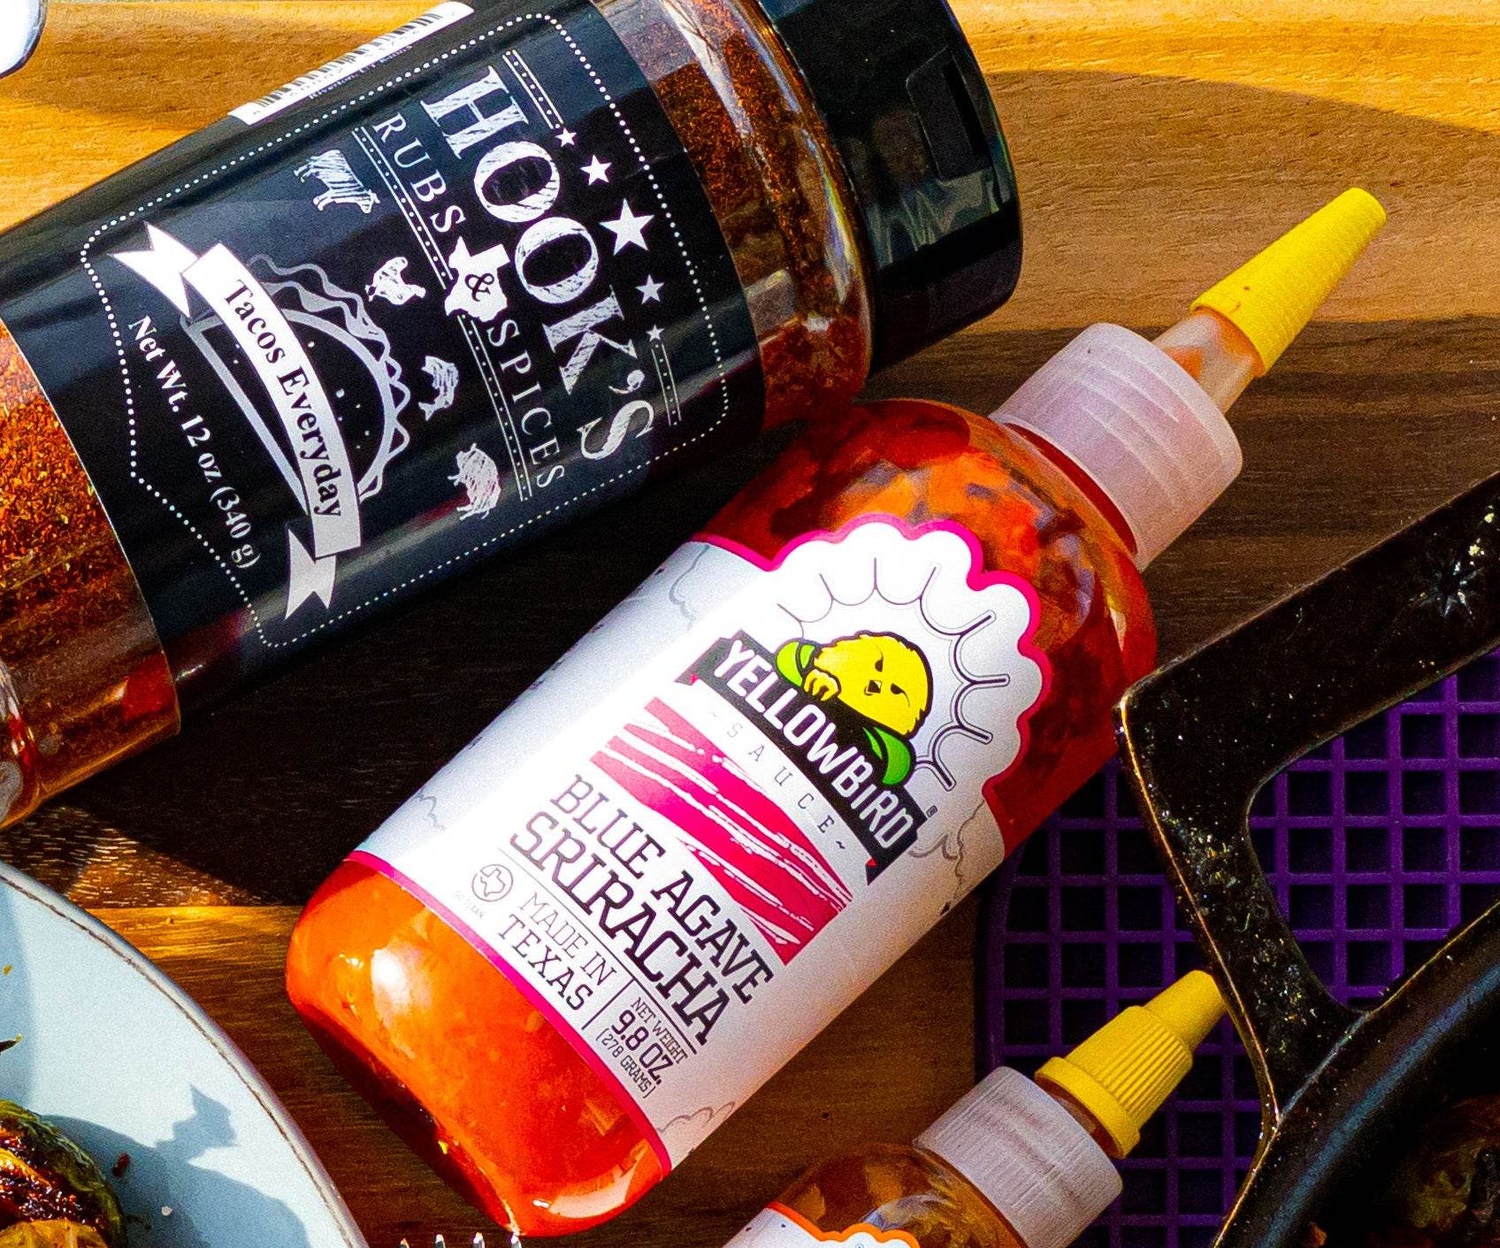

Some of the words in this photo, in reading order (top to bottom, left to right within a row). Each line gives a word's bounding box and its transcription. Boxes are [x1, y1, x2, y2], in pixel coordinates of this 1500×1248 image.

[372, 112, 466, 233] RUBS
[464, 272, 495, 302] &
[486, 318, 566, 488] SPICES
[420, 65, 655, 460] HOOK'S
[128, 315, 165, 361] Net
[156, 359, 188, 413] Wt.
[224, 279, 285, 364] Tacos
[276, 366, 342, 517] Everyday
[181, 415, 211, 447] 12
[198, 453, 222, 483] oz
[209, 486, 251, 539] (340
[231, 544, 261, 568] g)
[713, 639, 915, 850] YELLOWBIRD
[726, 722, 835, 834] SAUCE
[509, 811, 731, 1046] SRIRACHA
[549, 773, 666, 880] BLUE
[651, 869, 774, 1005] AGAVE
[498, 913, 594, 1011] TEXAS
[518, 891, 589, 959] MADE
[580, 951, 617, 986] IN
[595, 1027, 625, 1058] (278
[620, 1054, 657, 1099] GRAMS)
[611, 1008, 650, 1051] 9.8
[638, 1042, 674, 1085] OZ.
[630, 996, 656, 1024] NET
[651, 1020, 688, 1065] WEIGHT
